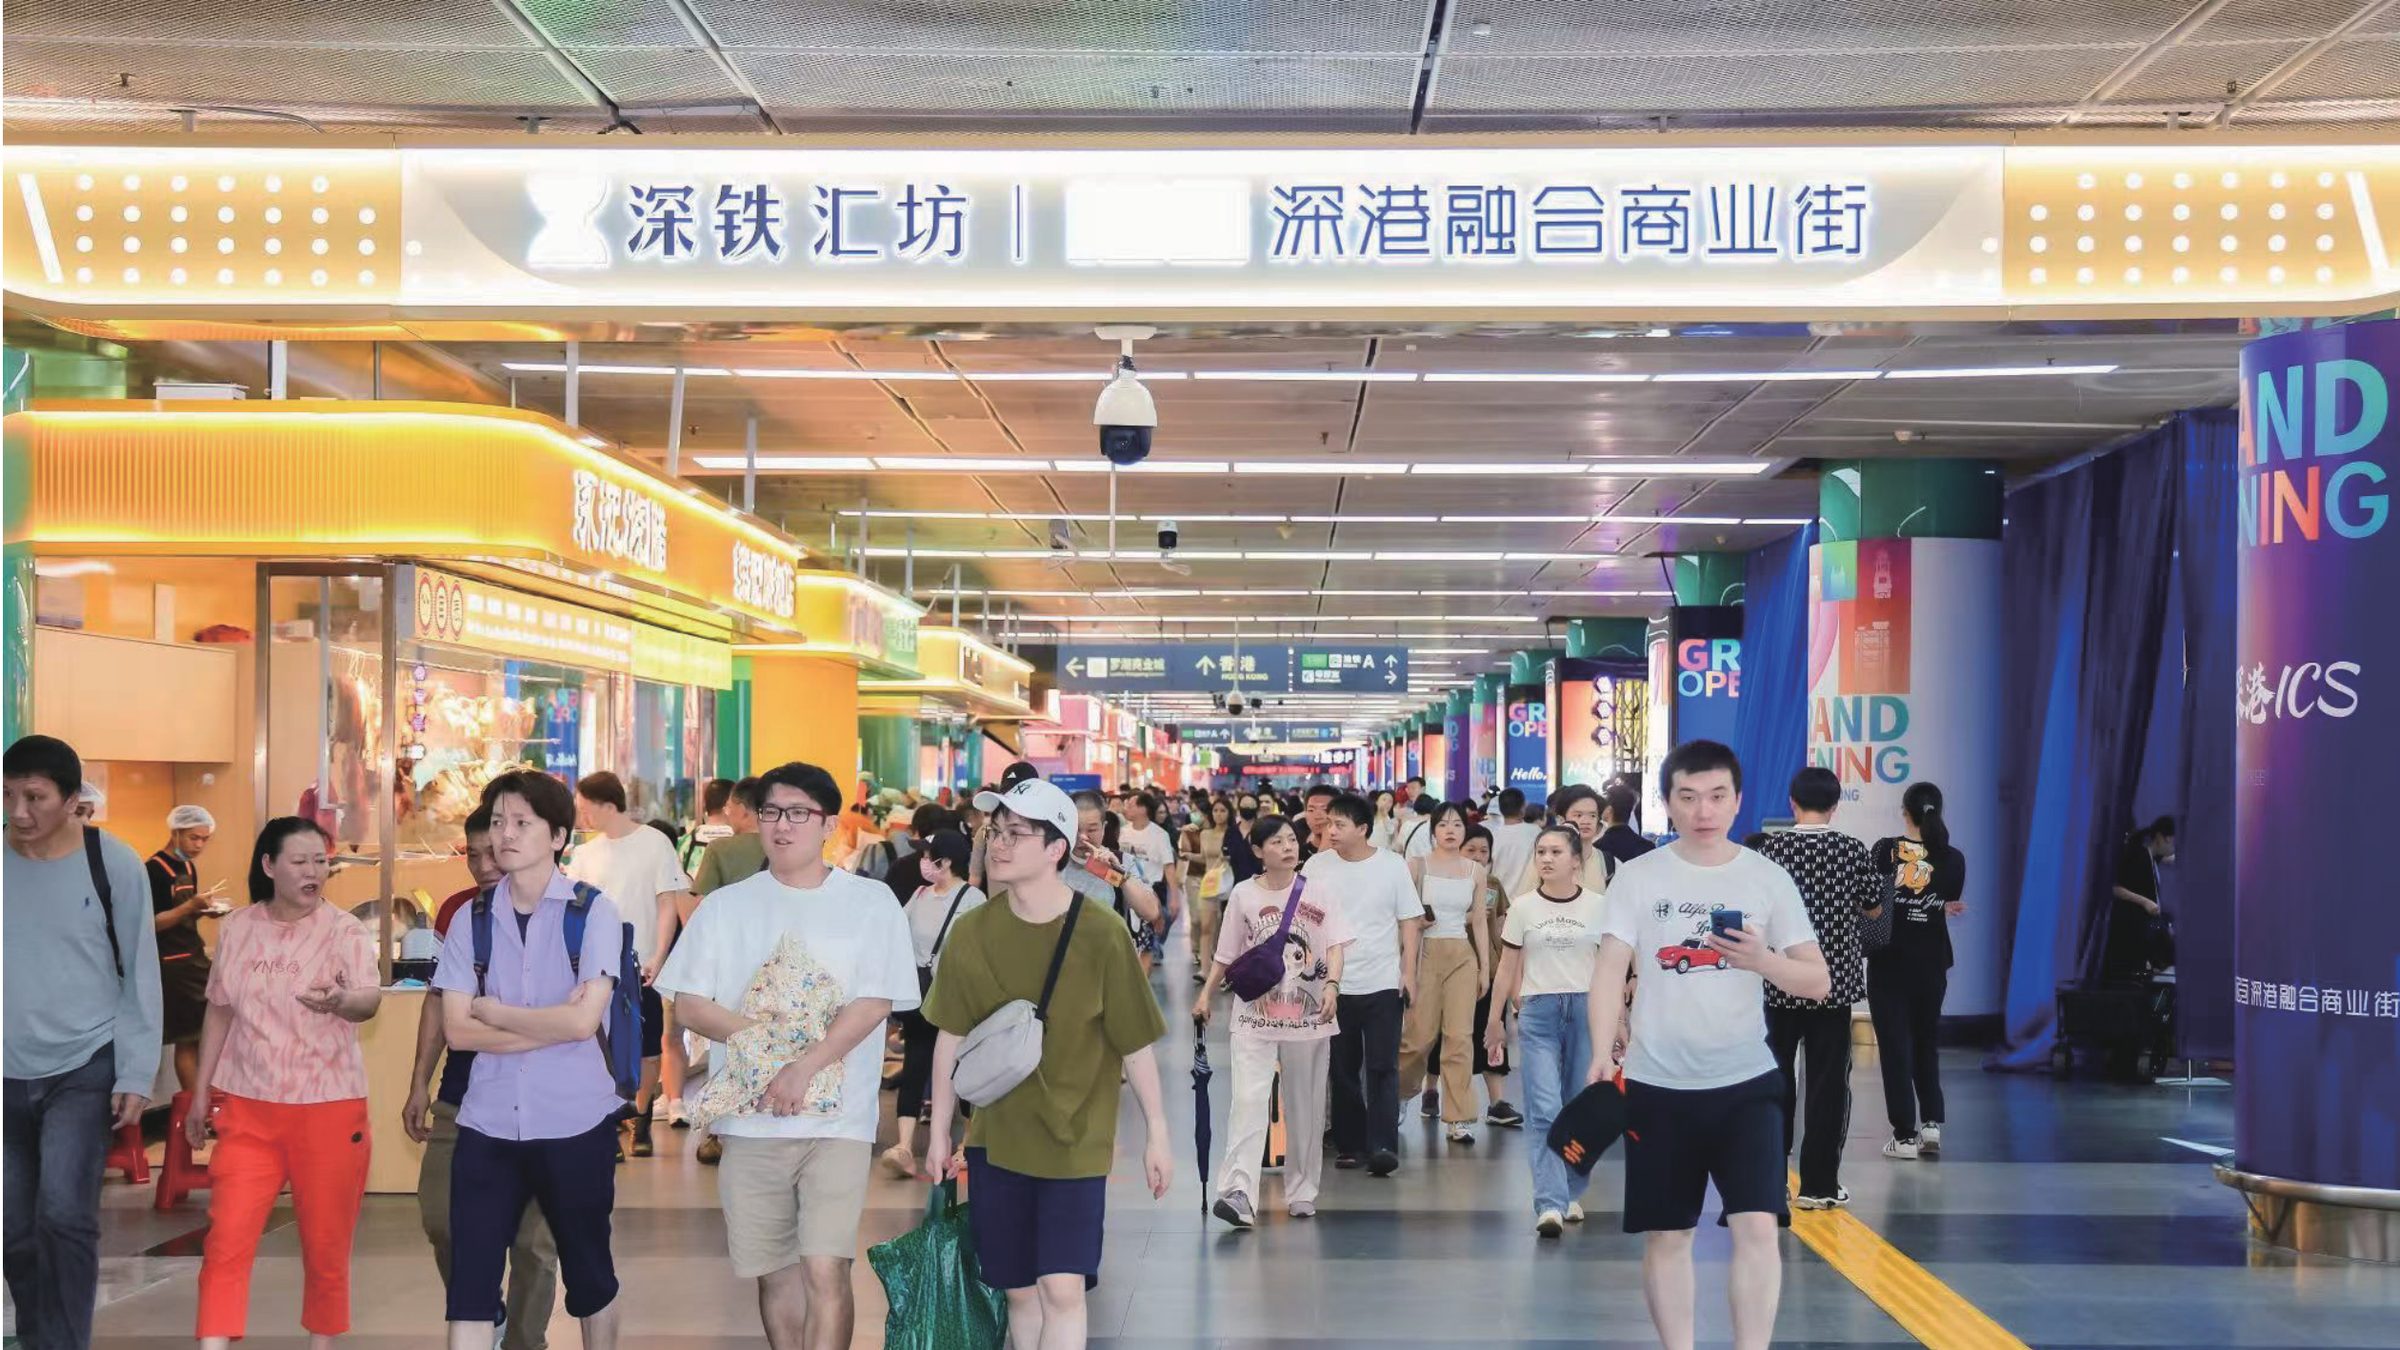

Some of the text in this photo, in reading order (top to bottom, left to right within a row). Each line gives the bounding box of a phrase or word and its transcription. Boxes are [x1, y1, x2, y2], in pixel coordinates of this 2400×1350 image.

[627, 183, 1867, 258] 深铁汇坊 深港融合商业街
[1219, 655, 1256, 672] 香港
[1362, 654, 1375, 669] A
[1678, 639, 1742, 671] GR
[1246, 672, 1269, 681] KONG
[1679, 902, 1707, 918] Alfa
